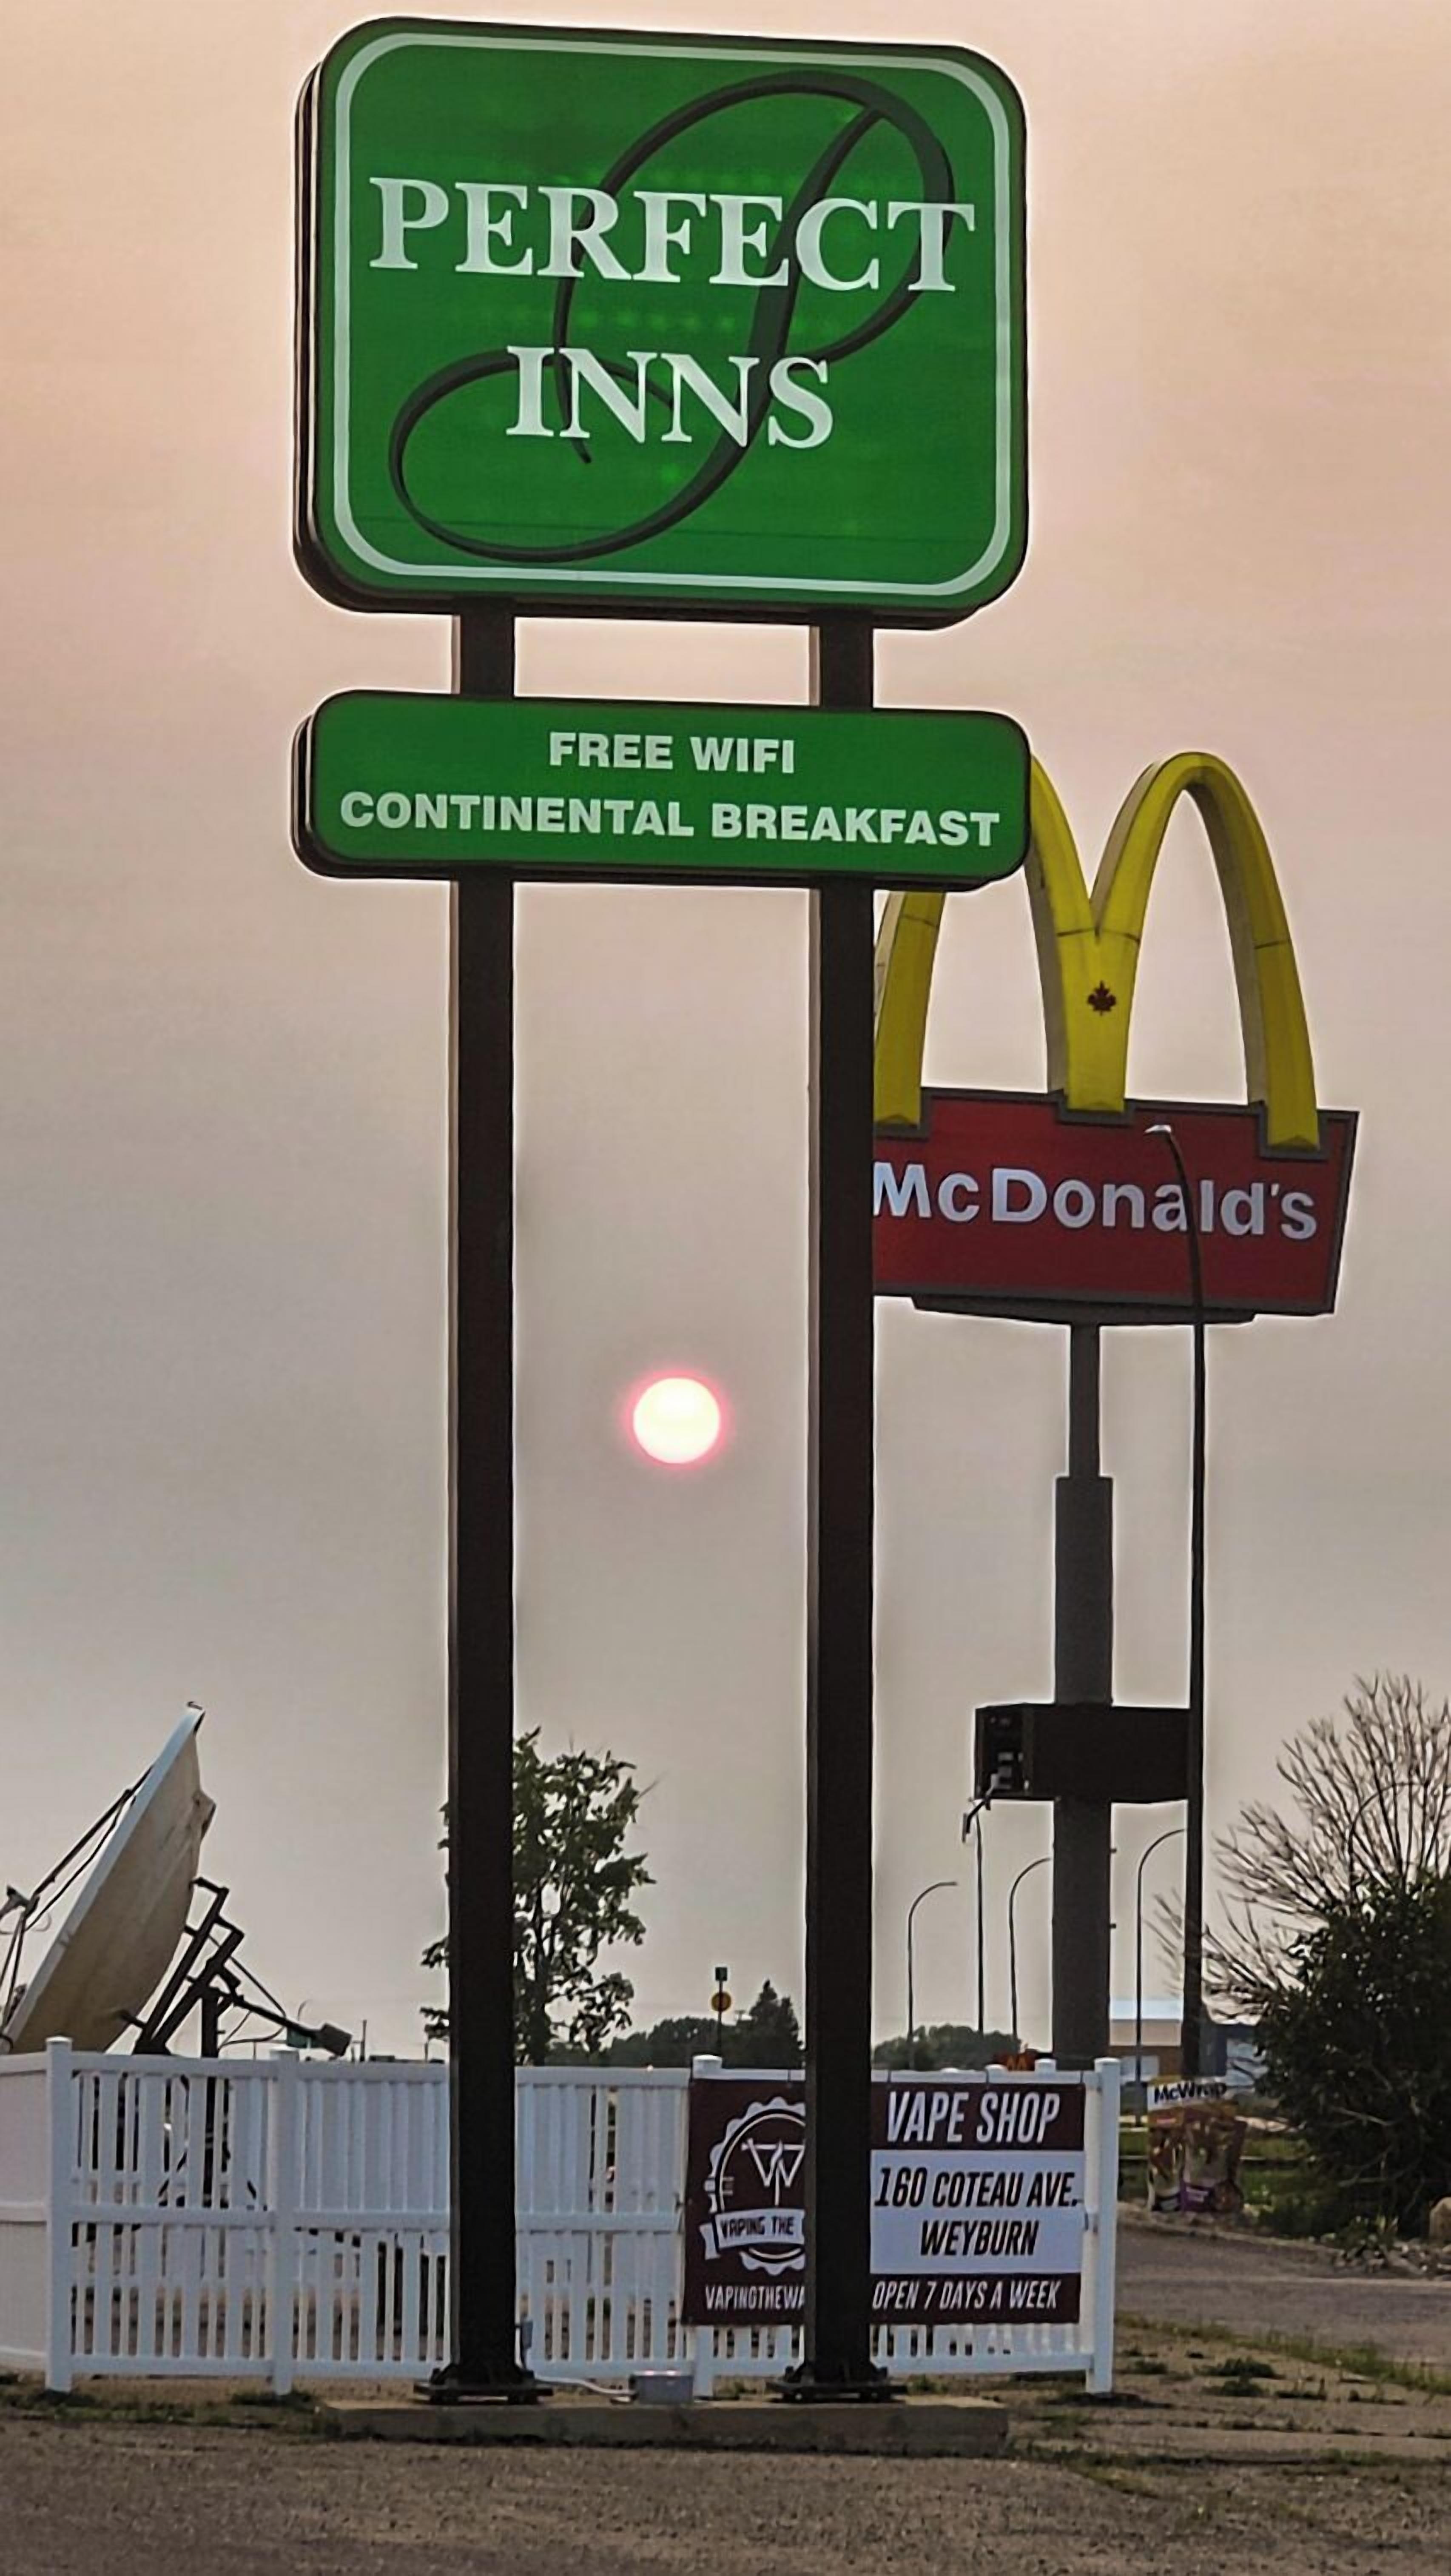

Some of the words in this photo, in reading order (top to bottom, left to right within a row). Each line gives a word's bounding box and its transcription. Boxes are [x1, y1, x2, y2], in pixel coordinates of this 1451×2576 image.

[369, 177, 975, 293] PERFECT
[506, 345, 833, 449] INNS
[549, 731, 673, 770] FREE
[691, 736, 795, 774] WIFI
[340, 792, 694, 837] CONTINENTAL
[711, 803, 999, 846] BREAKFAST
[873, 1161, 1317, 1240] McDonald's
[888, 2091, 969, 2143] VAPE
[976, 2092, 1060, 2143] SHOP
[875, 2167, 927, 2207] 160
[933, 2171, 1022, 2207] COTEAU
[1026, 2172, 1078, 2207] AVE.
[720, 2217, 765, 2239] VAPING
[771, 2216, 794, 2236] THE
[920, 2220, 1039, 2256] WEYBURN
[872, 2280, 917, 2309] OPEN
[923, 2281, 936, 2309] 7
[939, 2281, 987, 2310] DAYS
[990, 2281, 1003, 2309] A
[1010, 2281, 1062, 2308] WEEK
